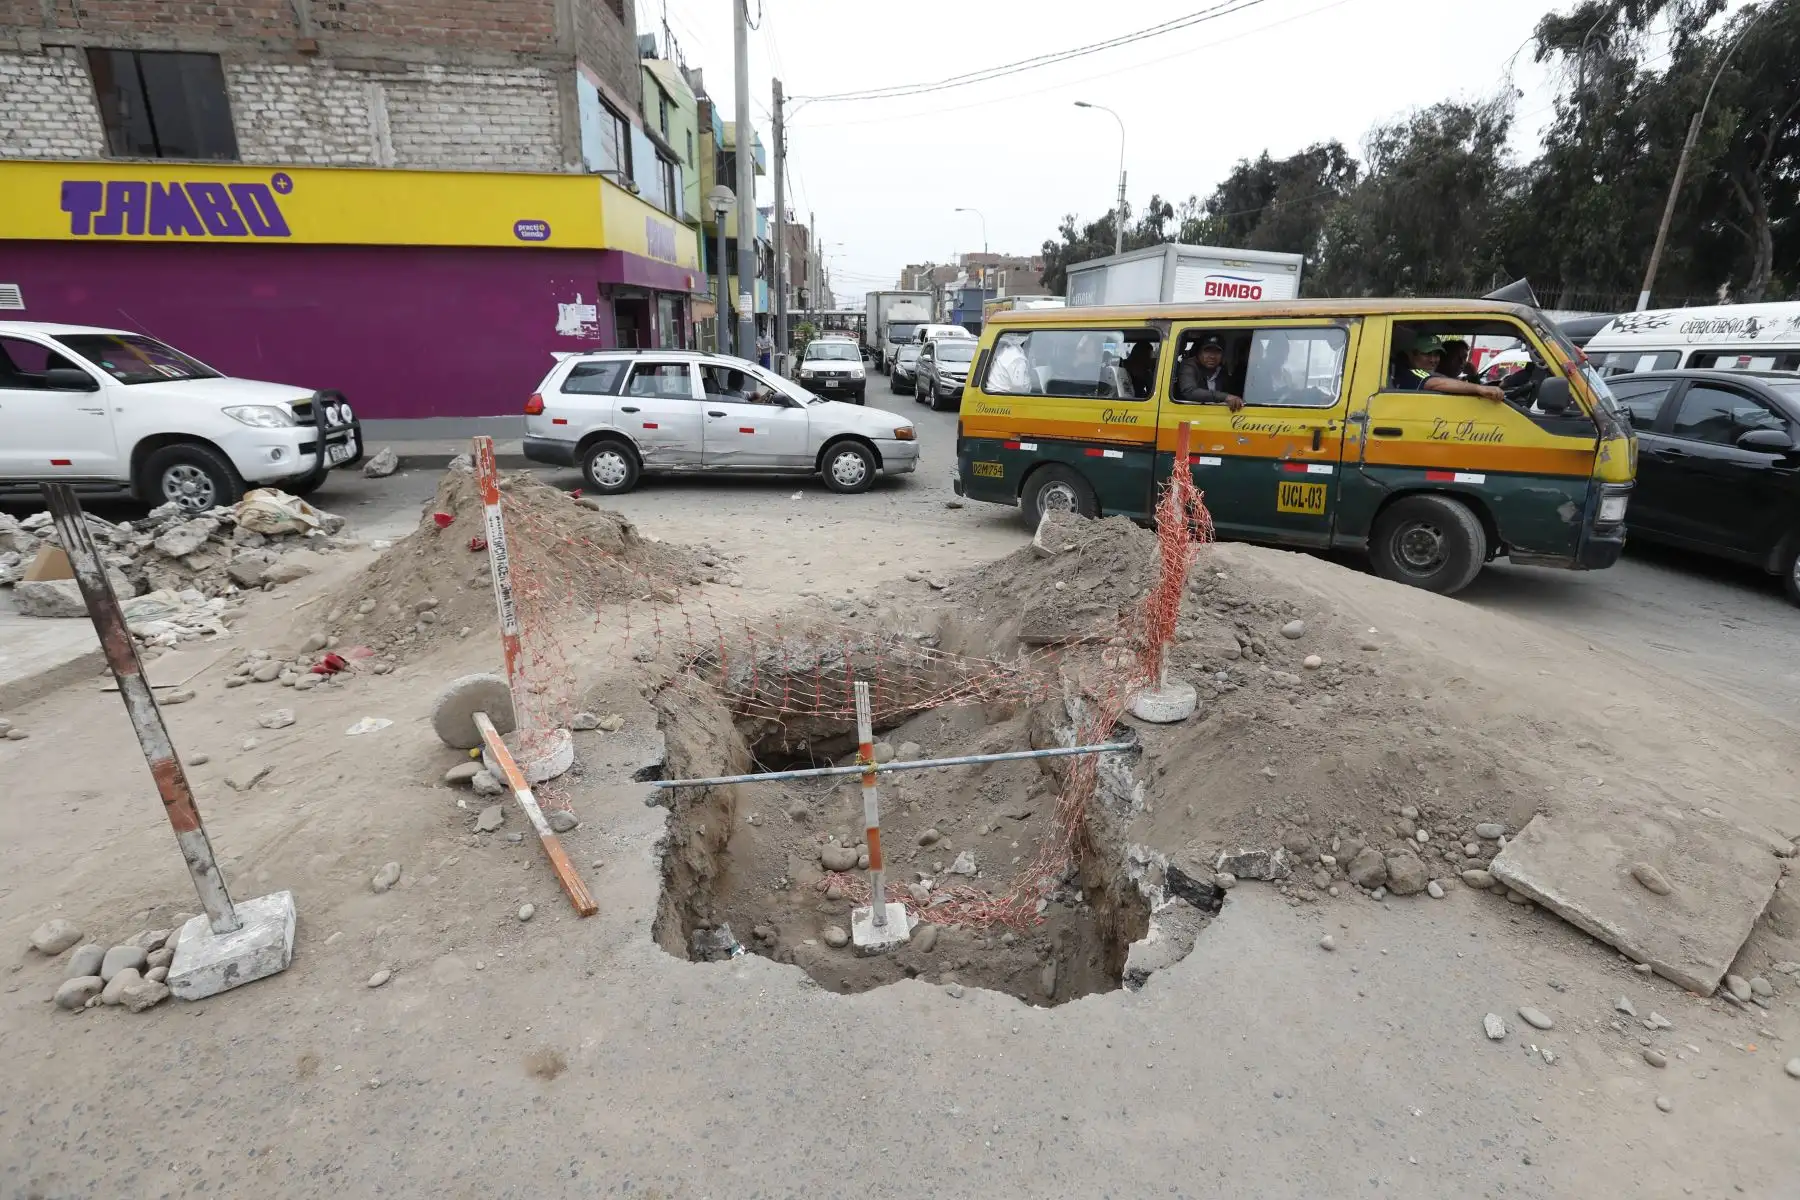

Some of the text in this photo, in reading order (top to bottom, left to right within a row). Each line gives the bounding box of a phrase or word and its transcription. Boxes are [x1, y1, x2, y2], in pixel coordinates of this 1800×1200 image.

[1204, 281, 1263, 300] BIMBO
[1102, 408, 1139, 425] Quilca
[1231, 415, 1292, 439] Concejo
[1427, 417, 1504, 442] La Punta
[1282, 484, 1322, 510] UCL-03
